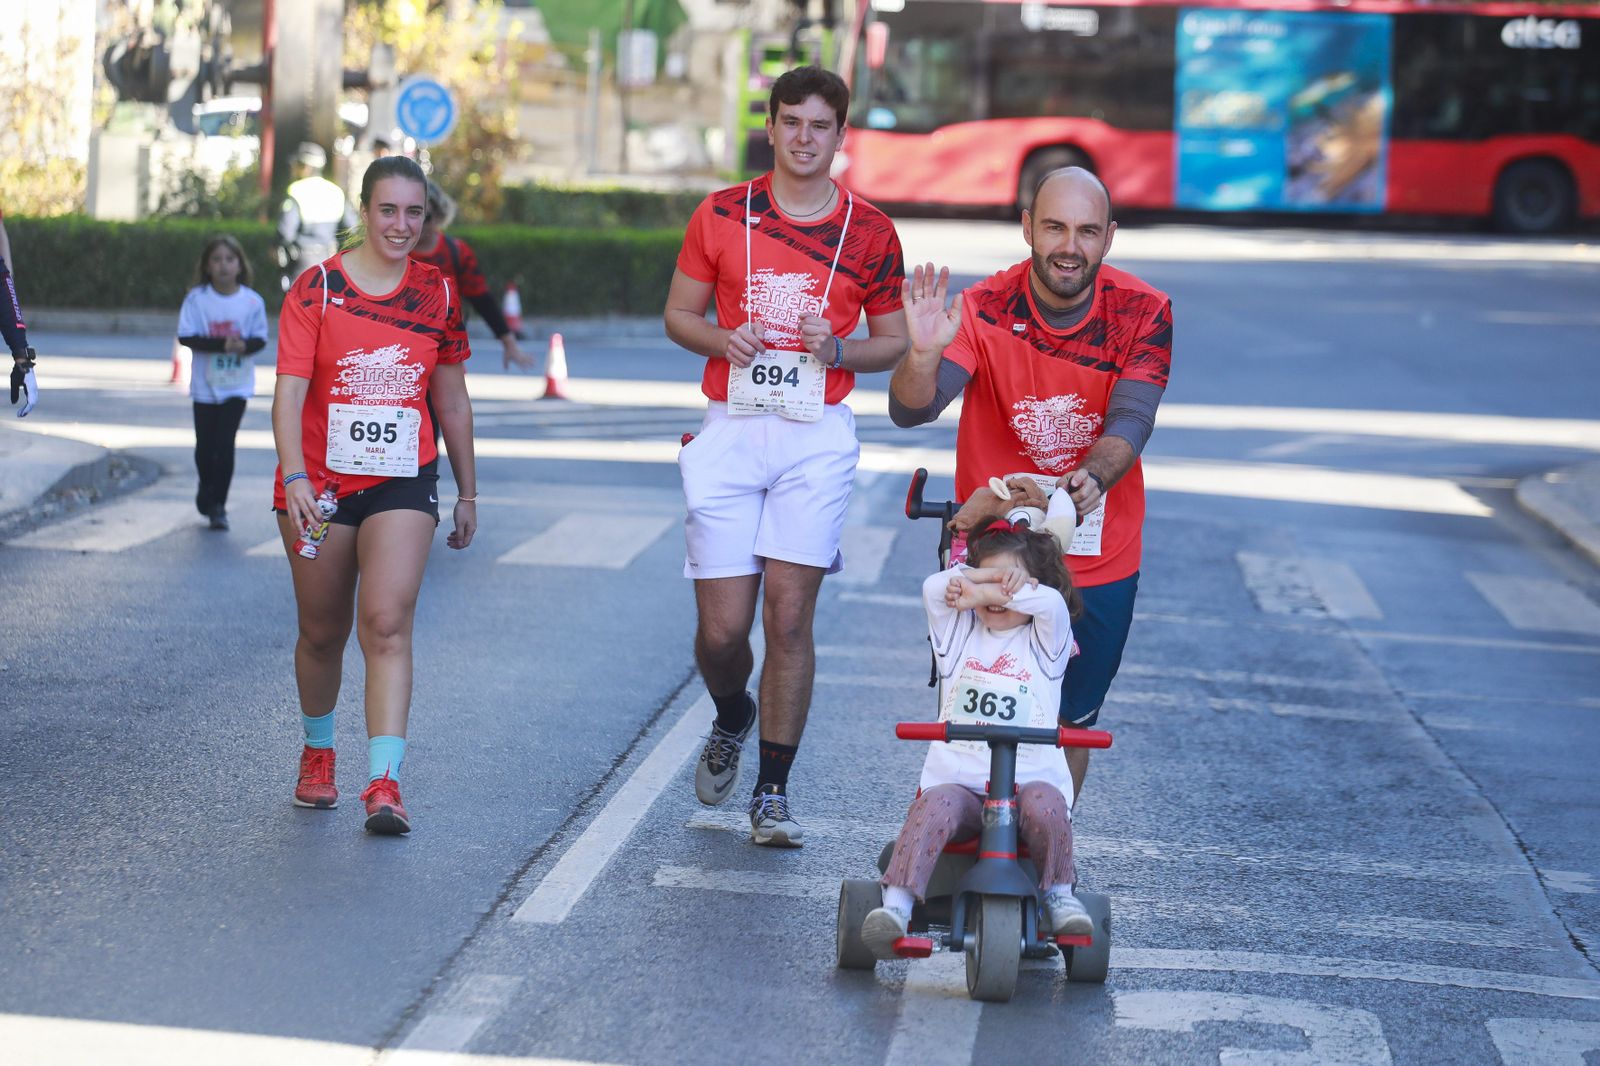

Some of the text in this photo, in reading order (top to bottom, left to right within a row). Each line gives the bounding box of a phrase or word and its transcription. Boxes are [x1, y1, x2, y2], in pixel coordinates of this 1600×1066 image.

[747, 285, 820, 315] carrera
[340, 367, 417, 382] carrera
[752, 364, 799, 388] 694
[341, 382, 416, 396] cruzroja.es
[350, 420, 397, 443] 695
[963, 688, 1017, 720] 363
